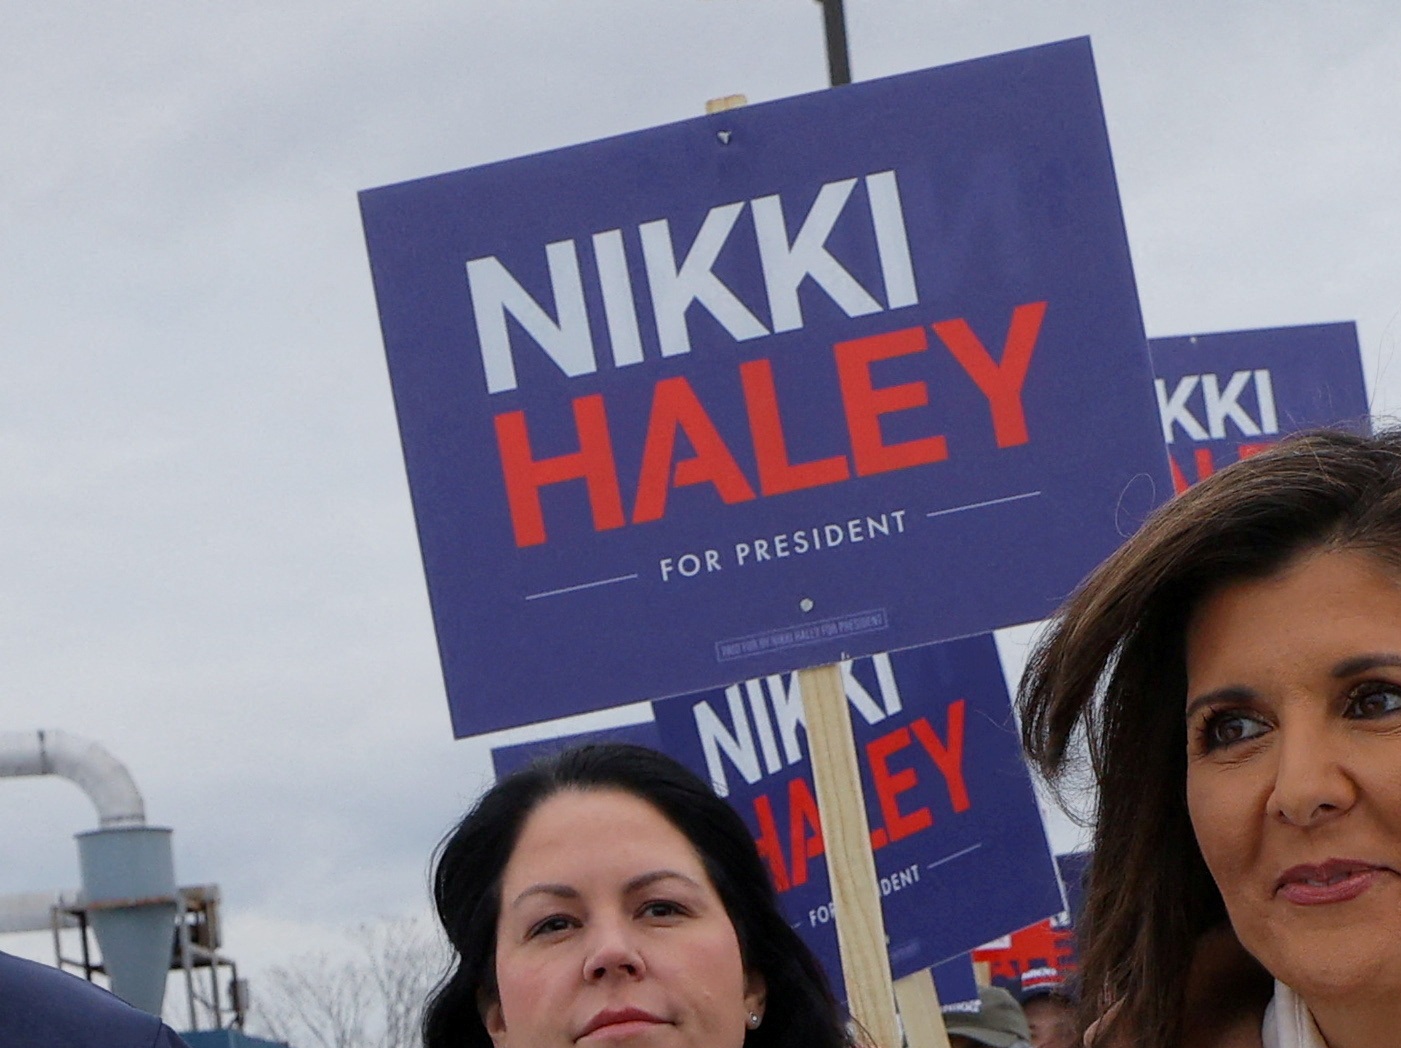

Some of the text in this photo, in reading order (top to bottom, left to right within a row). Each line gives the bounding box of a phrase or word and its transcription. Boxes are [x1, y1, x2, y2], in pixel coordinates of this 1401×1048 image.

[466, 169, 919, 394] NIKKI
[493, 301, 1049, 548] HALEY
[659, 510, 909, 582] FOR PRESIDENT
